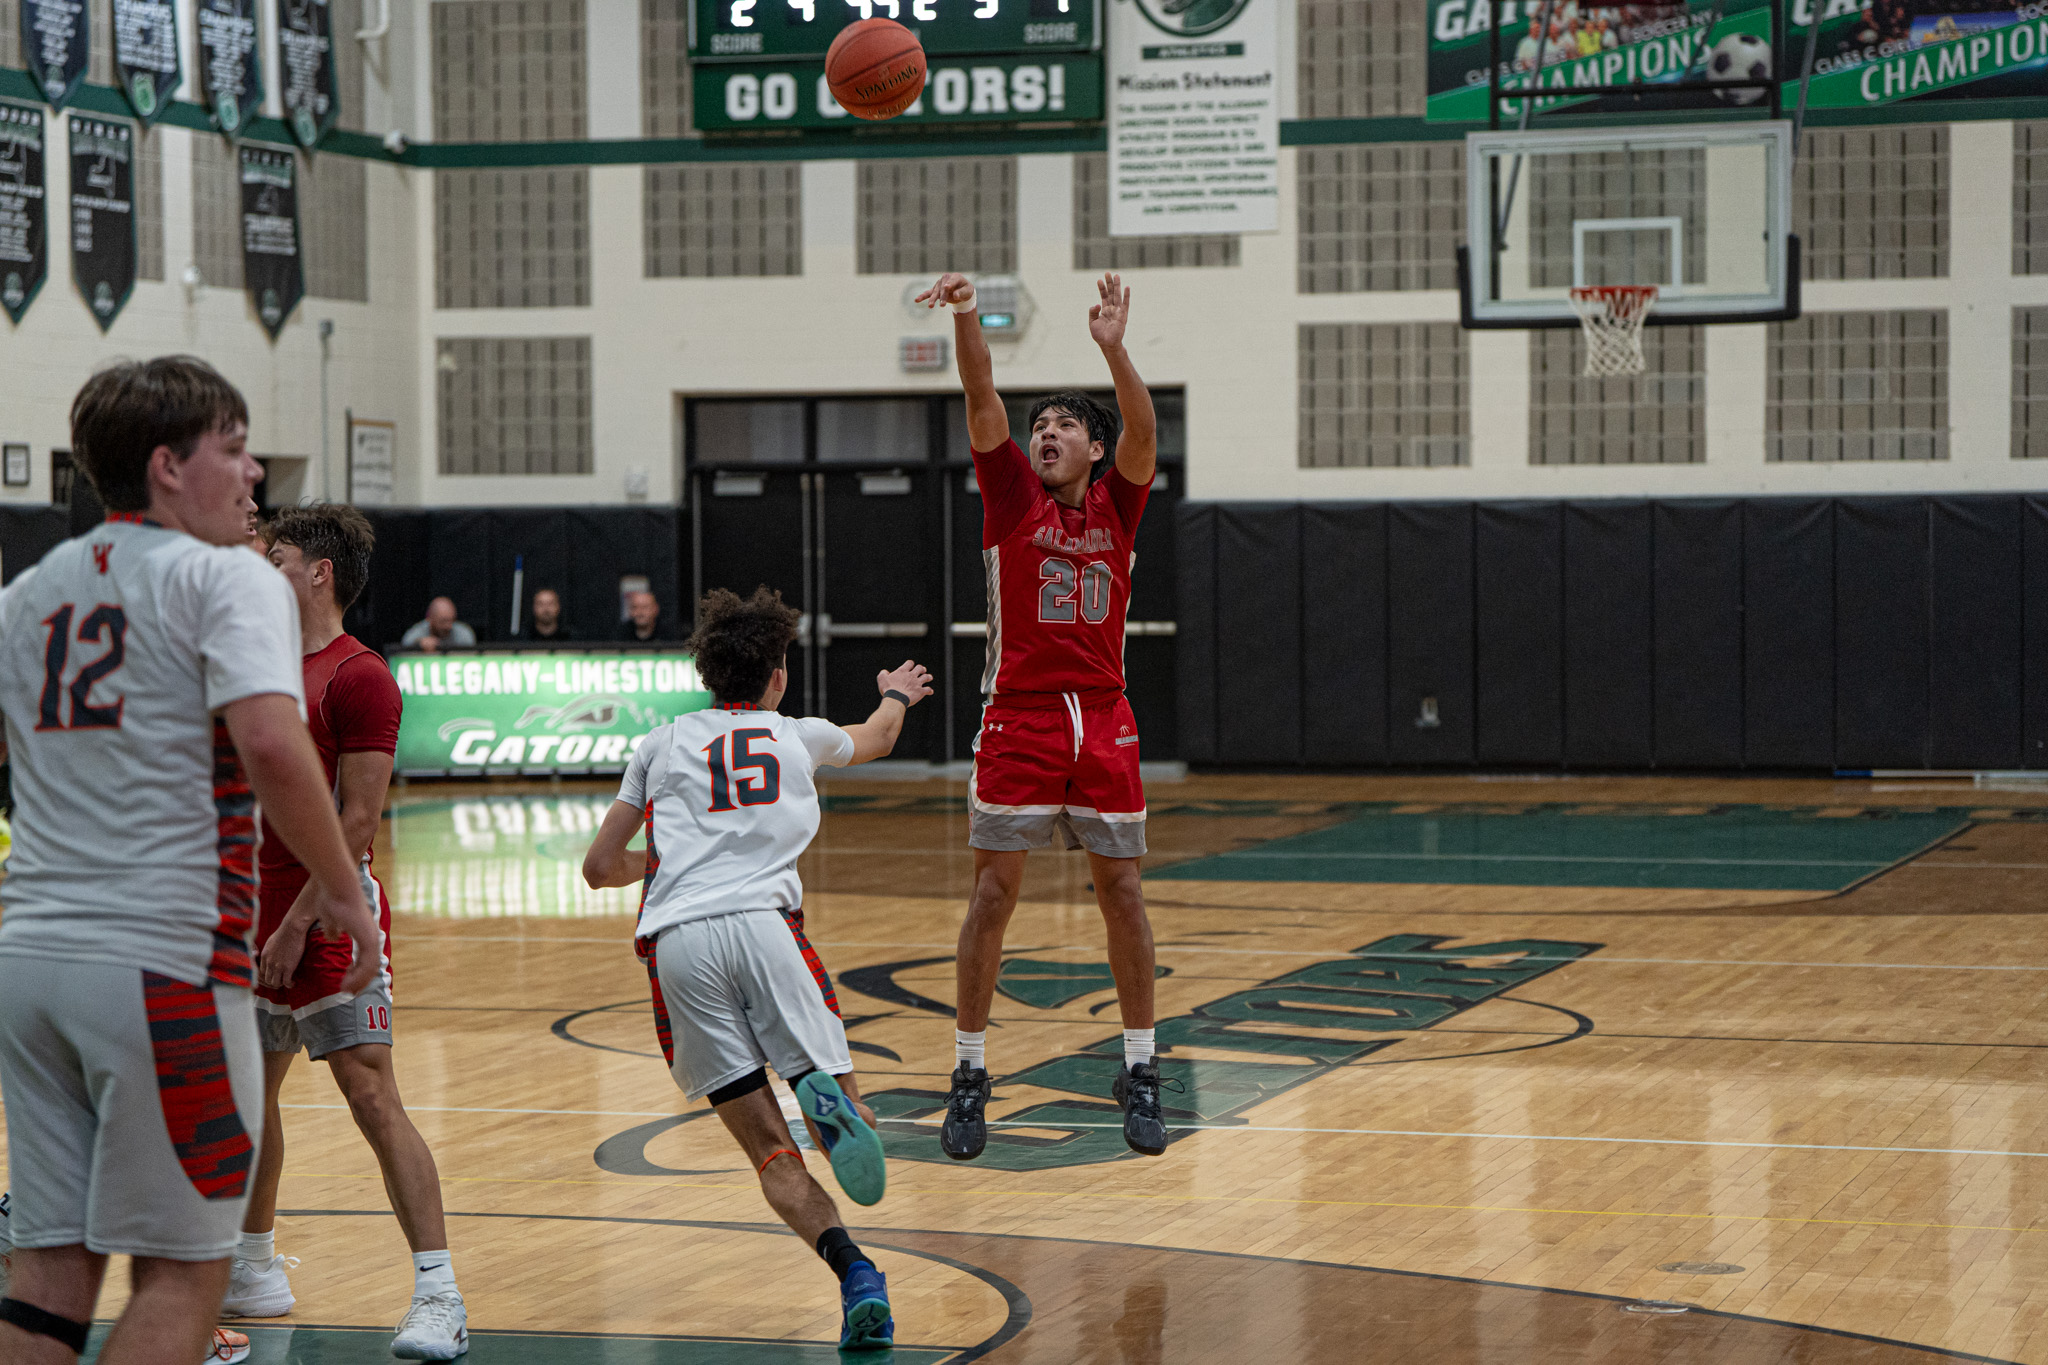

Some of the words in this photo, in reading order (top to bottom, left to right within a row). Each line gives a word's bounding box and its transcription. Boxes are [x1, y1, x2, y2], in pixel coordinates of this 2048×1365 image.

[711, 33, 763, 54] SCORE
[1023, 22, 1078, 43] SCORE
[725, 73, 798, 121] GO
[855, 65, 918, 101] SPALDING
[1117, 73, 1179, 91] Mission
[1182, 70, 1272, 88] Statement
[1038, 556, 1114, 624] 20
[34, 603, 128, 733] 12
[701, 727, 781, 813] 15
[365, 1004, 388, 1031] 10
